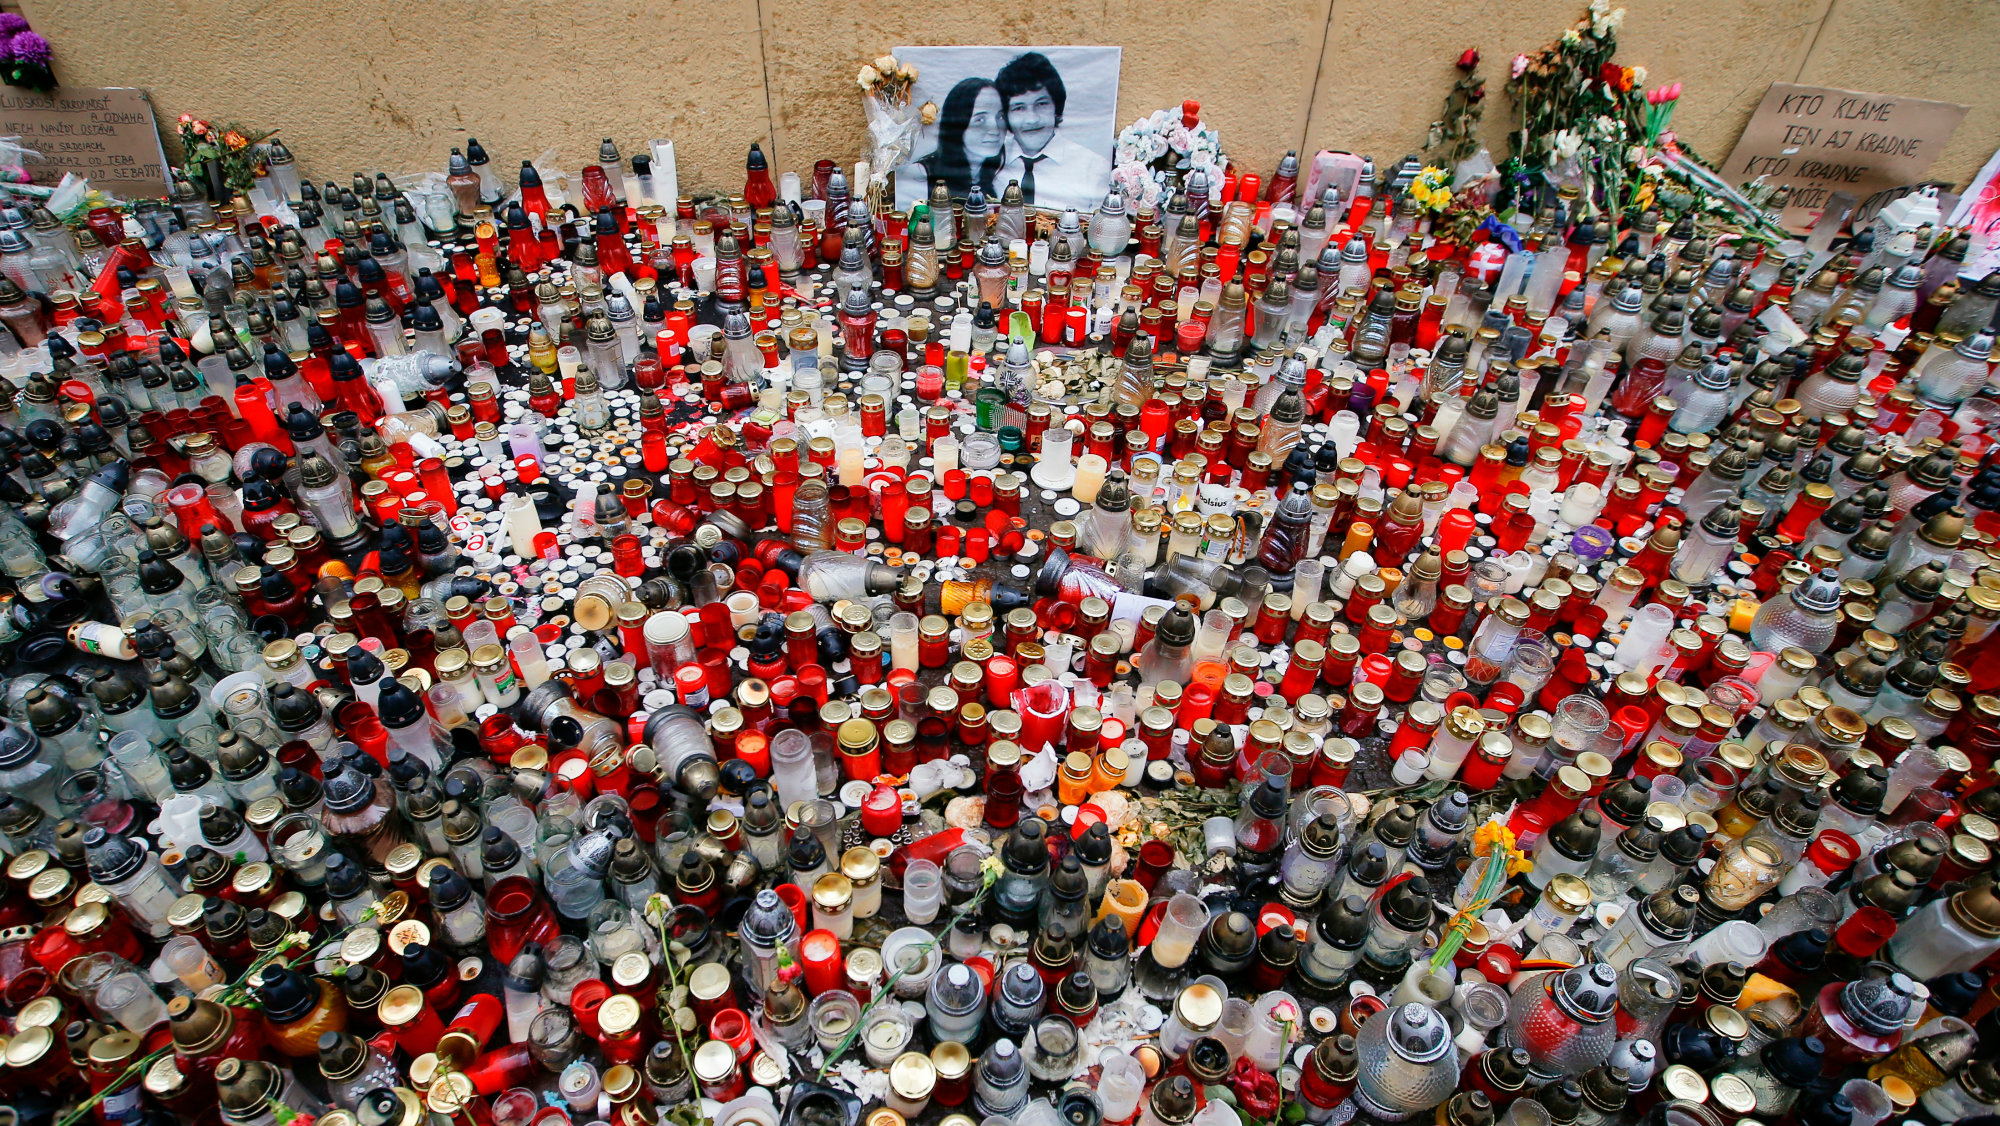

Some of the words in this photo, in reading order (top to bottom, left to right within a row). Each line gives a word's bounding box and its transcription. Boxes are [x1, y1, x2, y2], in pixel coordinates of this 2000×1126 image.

[1777, 94, 1825, 116] KTO
[1832, 98, 1896, 122] KLAME
[91, 112, 99, 121] A
[104, 112, 145, 123] ODVAHA
[5, 122, 34, 133] NECH
[1781, 125, 1822, 146] TEN
[1823, 130, 1853, 149] AJ
[1855, 132, 1923, 158] KRADNE,
[88, 156, 102, 165] OD
[107, 155, 135, 165] TEBA
[91, 170, 105, 179] OD
[1742, 155, 1790, 176] KTO
[1794, 160, 1869, 183] KRADNE
